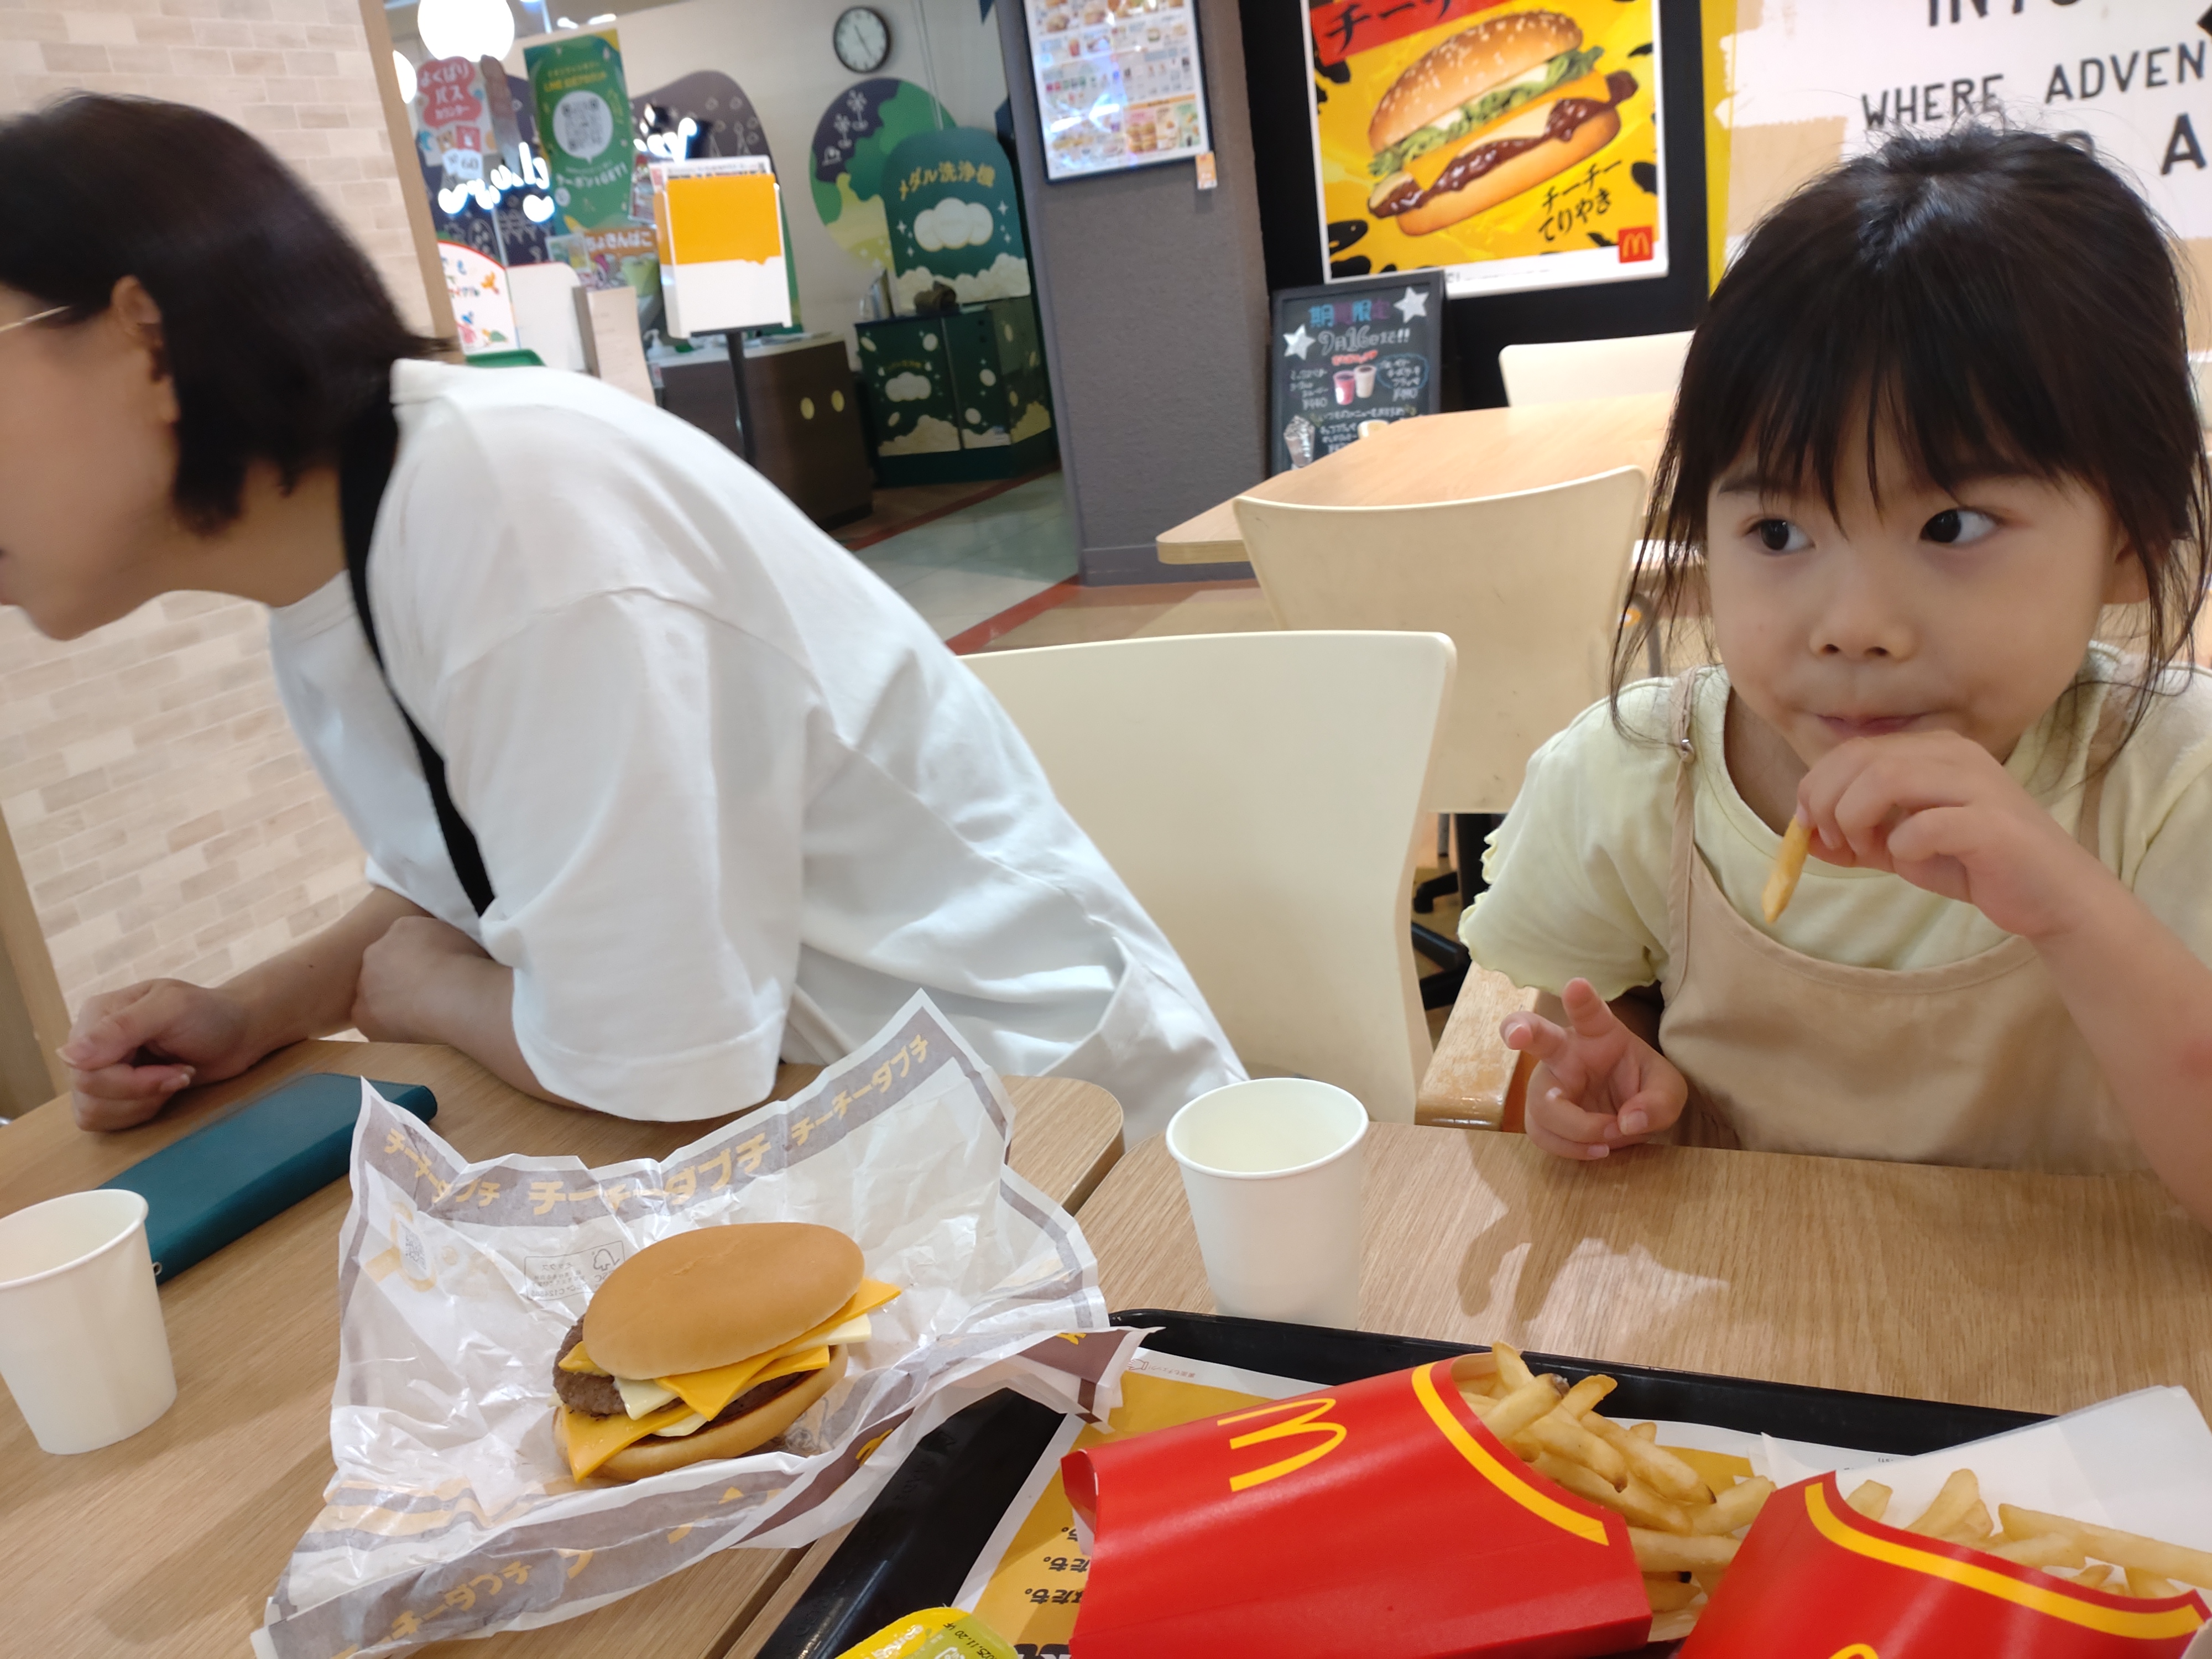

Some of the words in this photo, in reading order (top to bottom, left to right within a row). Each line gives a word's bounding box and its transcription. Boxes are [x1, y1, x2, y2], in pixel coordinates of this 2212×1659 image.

[420, 62, 468, 87] よくばり
[435, 85, 464, 105] パス
[1861, 74, 2005, 129] WHERE
[2044, 40, 2206, 104] ADVEN
[898, 160, 997, 201] メダル洗浄機
[1542, 157, 1623, 216] チーチー
[1538, 188, 1613, 243] てりやき
[791, 1034, 929, 1147] チーチーダブチ
